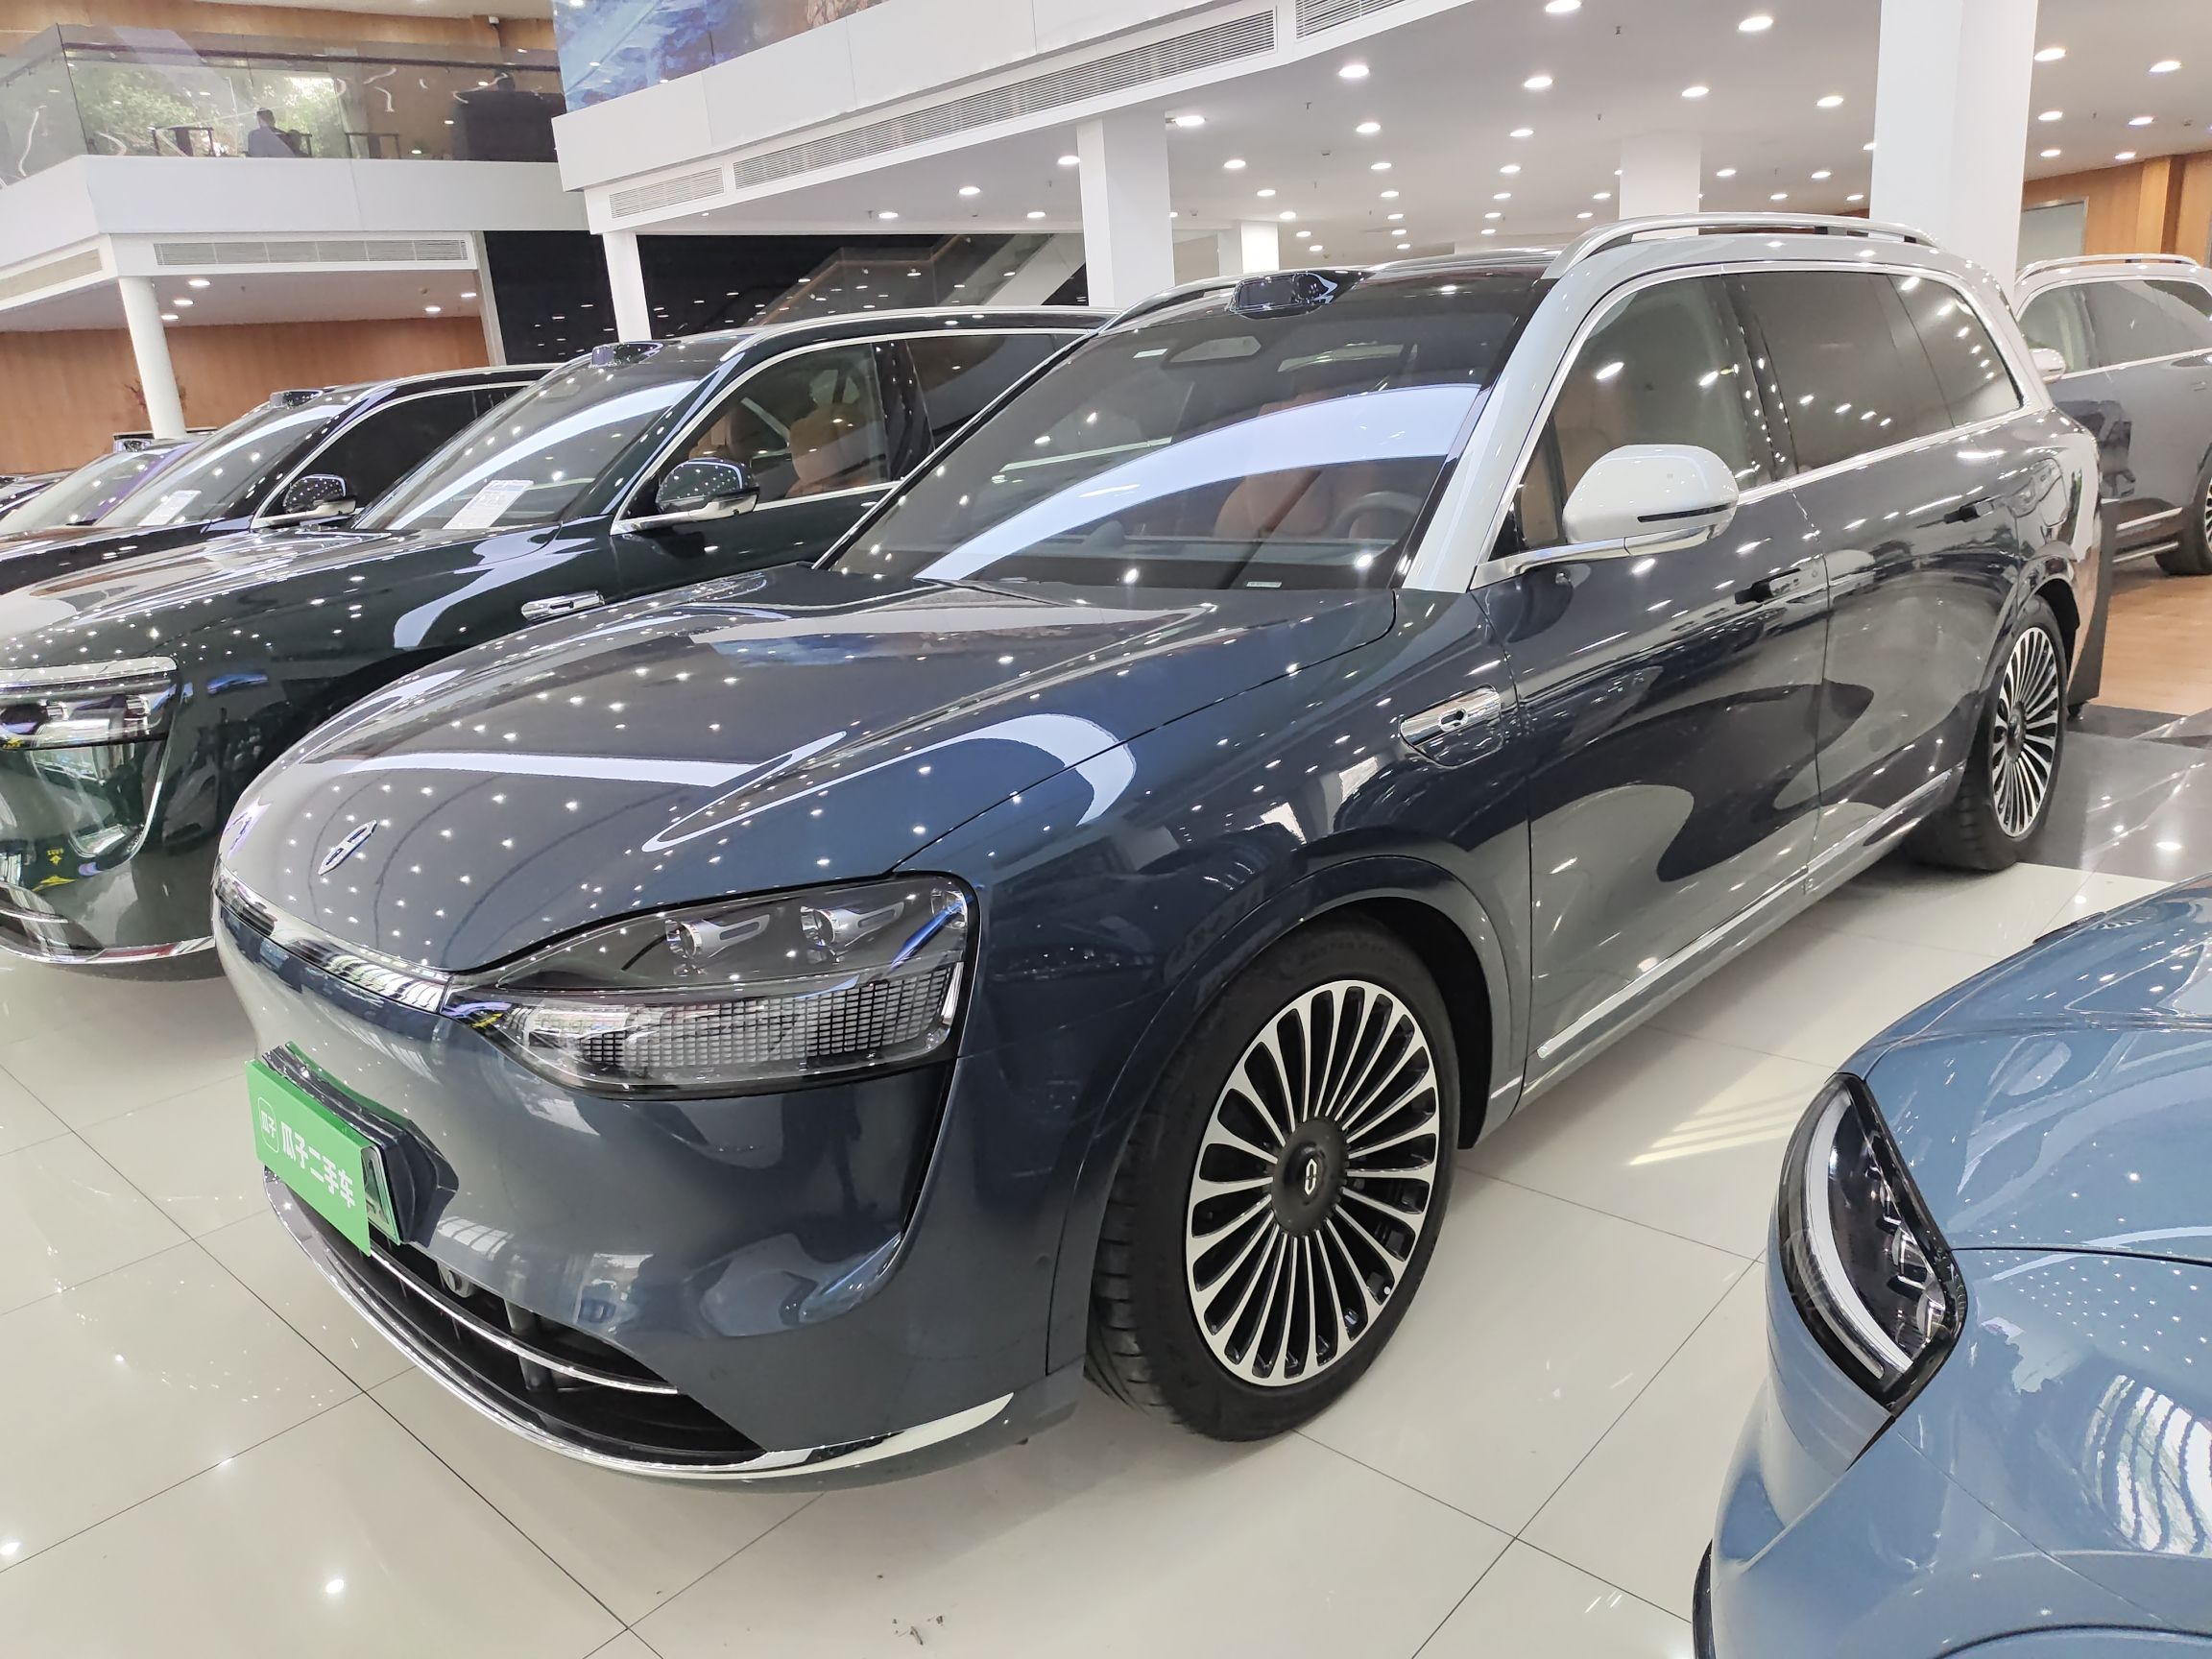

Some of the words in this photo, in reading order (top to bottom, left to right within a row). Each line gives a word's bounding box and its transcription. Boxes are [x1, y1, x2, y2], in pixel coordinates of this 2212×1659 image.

[260, 1109, 276, 1138] 瓜子
[280, 1120, 356, 1209] 瓜子二手车
